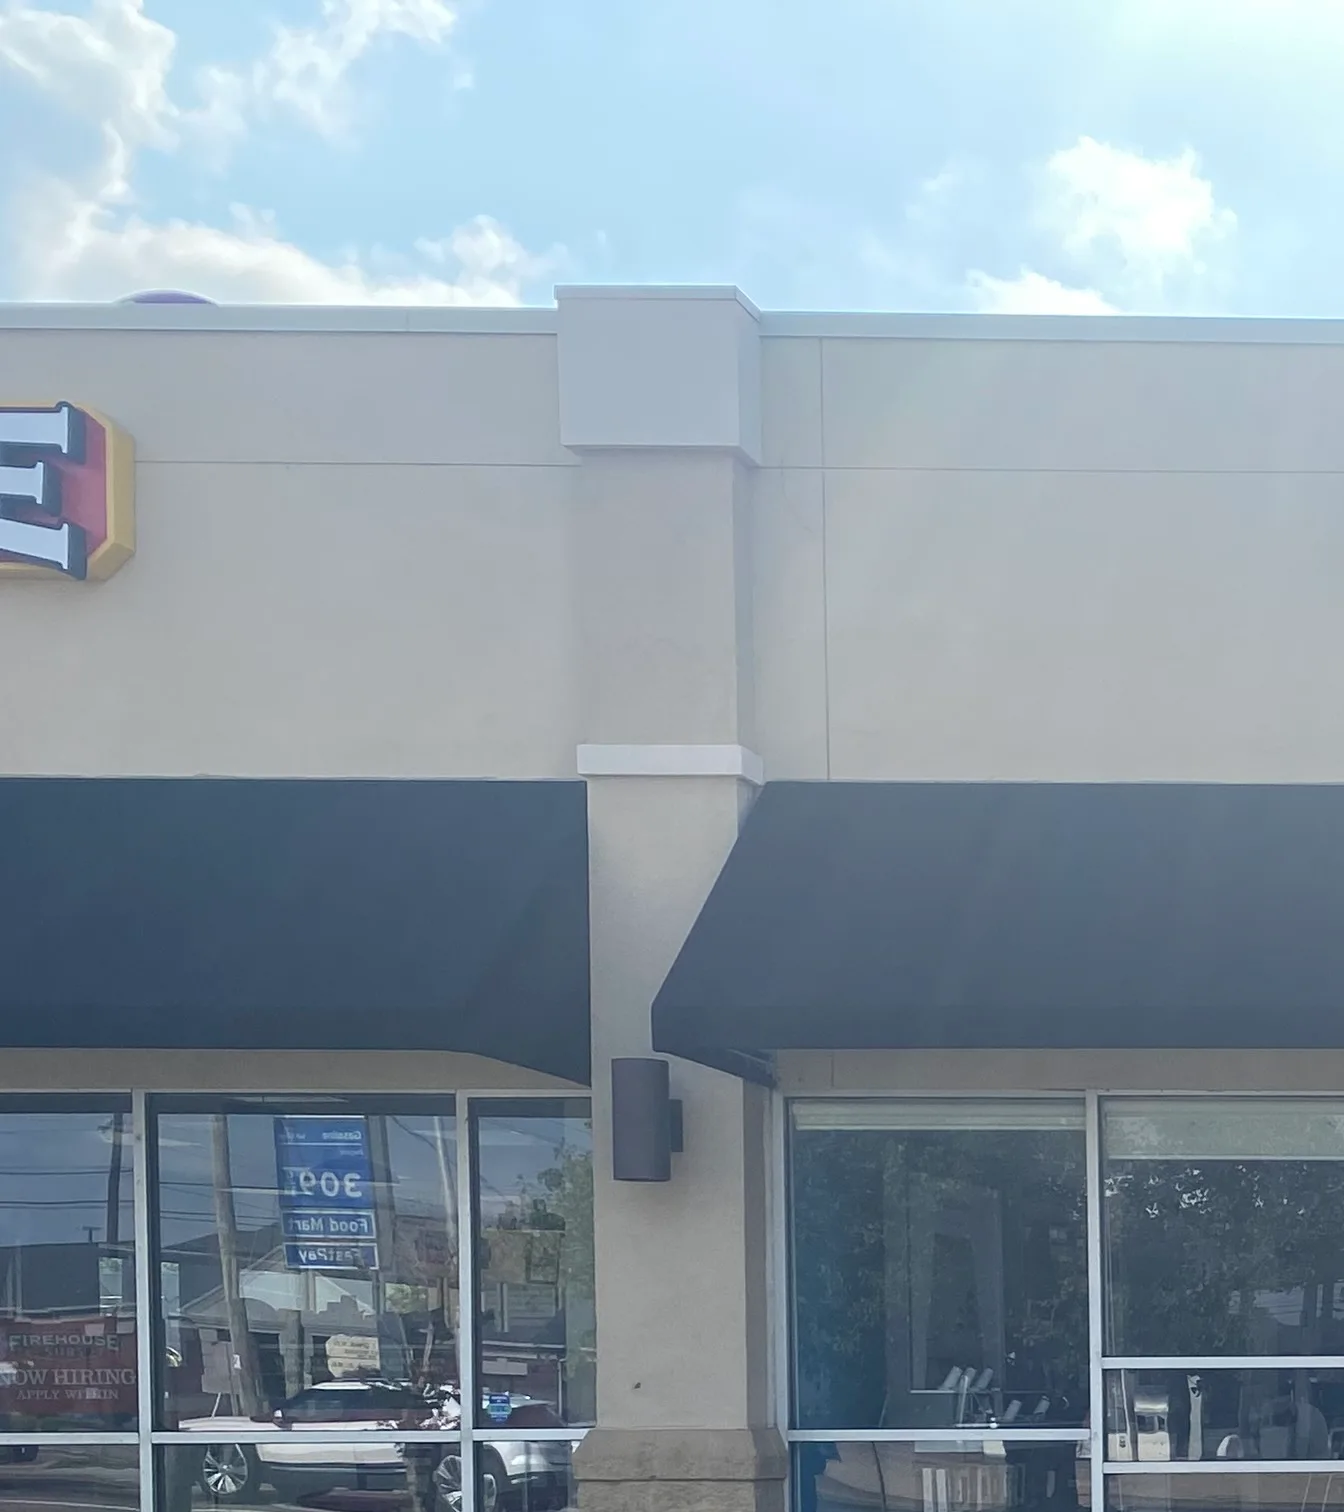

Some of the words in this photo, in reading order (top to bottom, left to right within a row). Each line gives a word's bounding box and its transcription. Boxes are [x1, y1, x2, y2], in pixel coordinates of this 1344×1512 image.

[9, 1334, 119, 1351] FIREHOUSE
[52, 1368, 136, 1385] HIRING
[17, 1389, 59, 1400] APPLY
